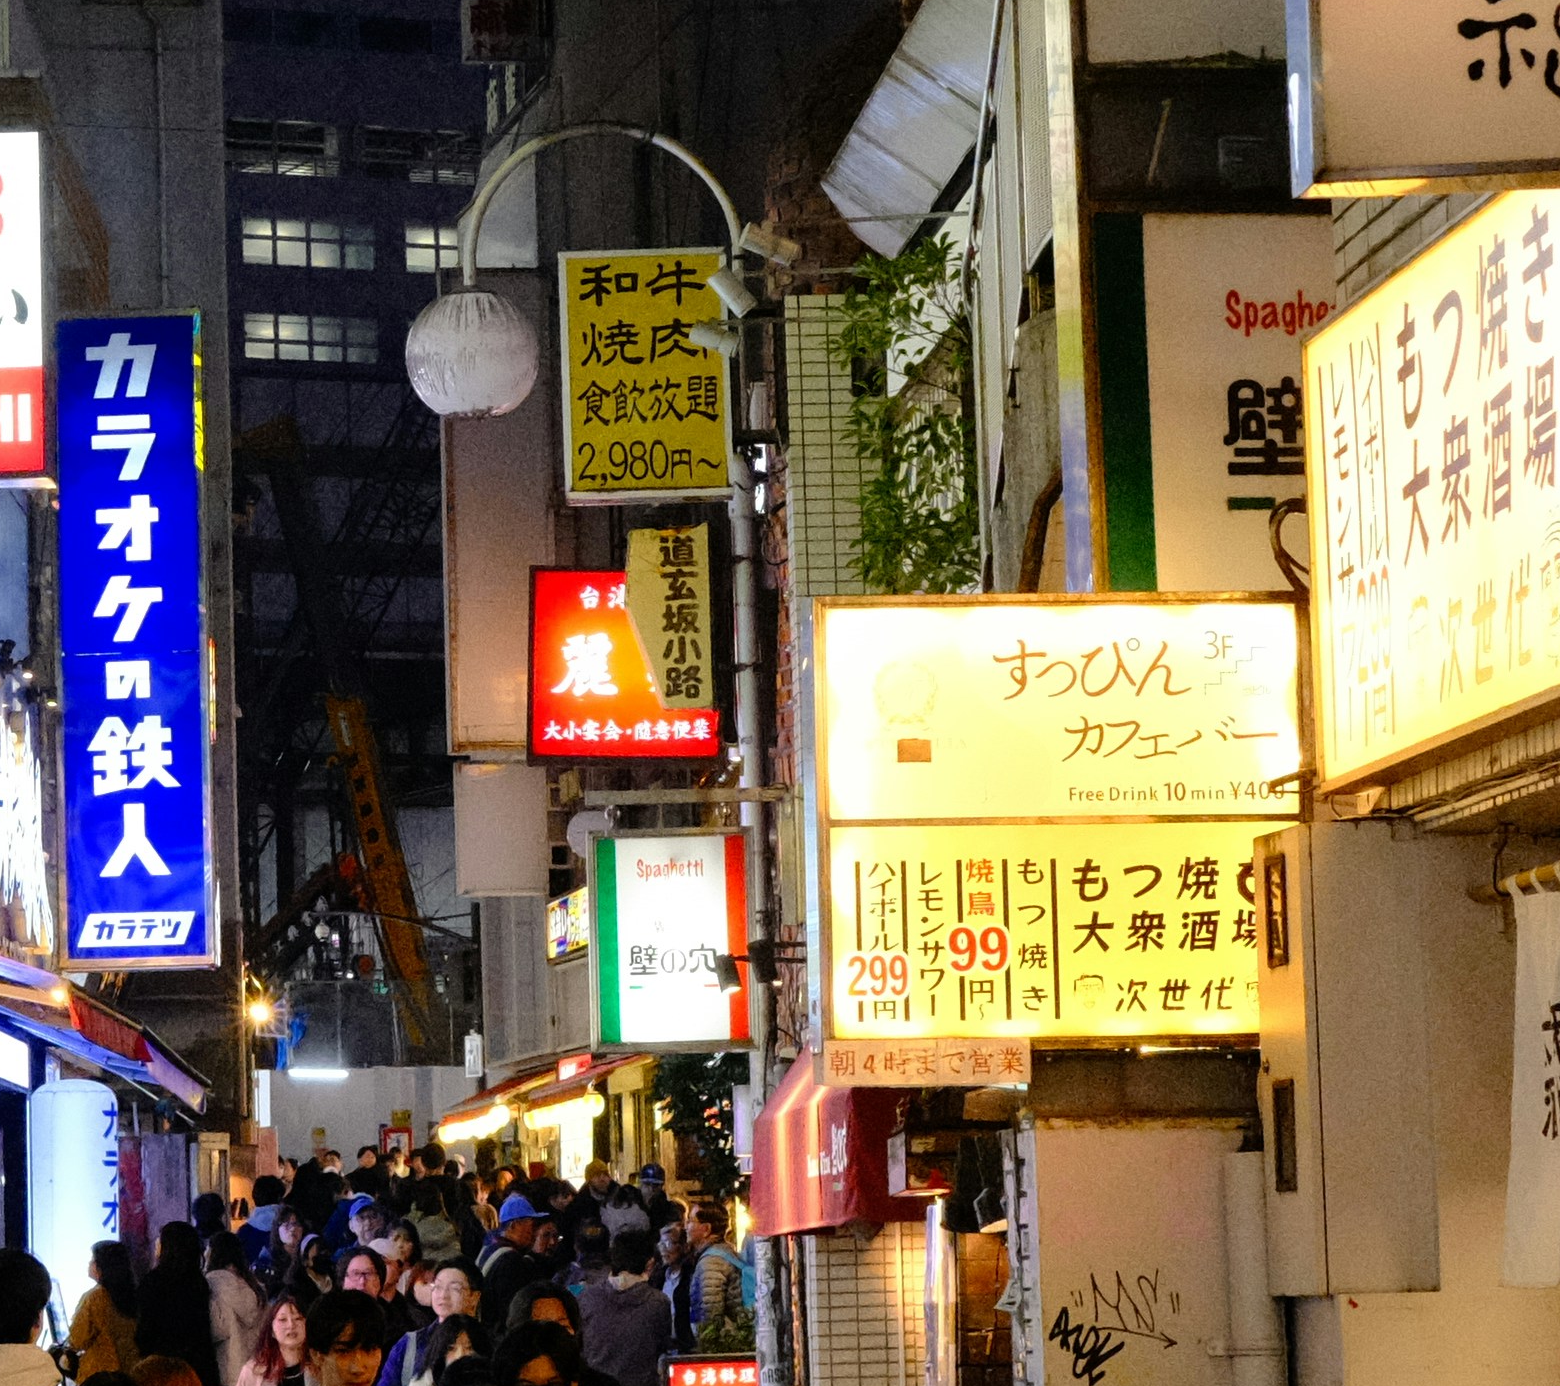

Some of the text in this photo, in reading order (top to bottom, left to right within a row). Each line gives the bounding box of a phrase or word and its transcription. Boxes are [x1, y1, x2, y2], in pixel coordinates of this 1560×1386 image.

[578, 262, 707, 307] 和牛
[1395, 202, 1557, 431] もつ焼き
[1400, 356, 1558, 569] 大衆酒場
[85, 332, 181, 878] カラオケの鉄人
[658, 533, 703, 700] 道玄坂小路
[1438, 552, 1533, 705] 次世代
[992, 638, 1192, 701] すっぴん
[1204, 630, 1234, 660] 3F
[1061, 713, 1279, 763] カフェバー
[1068, 786, 1105, 802] Free
[1109, 785, 1158, 801] Drink
[1164, 783, 1186, 800] 10
[1191, 785, 1225, 801] min
[636, 856, 704, 881] Spaghetti
[966, 858, 996, 918] 焼鳥
[91, 917, 182, 943] カラテツ
[867, 860, 900, 952] ハイボール
[1073, 910, 1259, 954] 大衆酒場
[629, 944, 719, 975] 壁の穴
[916, 860, 946, 1017] レモンサワー
[1017, 858, 1049, 1012] もつ焼き
[1114, 974, 1235, 1013] 次世代
[828, 1047, 1026, 1076] 朝4時まで営業
